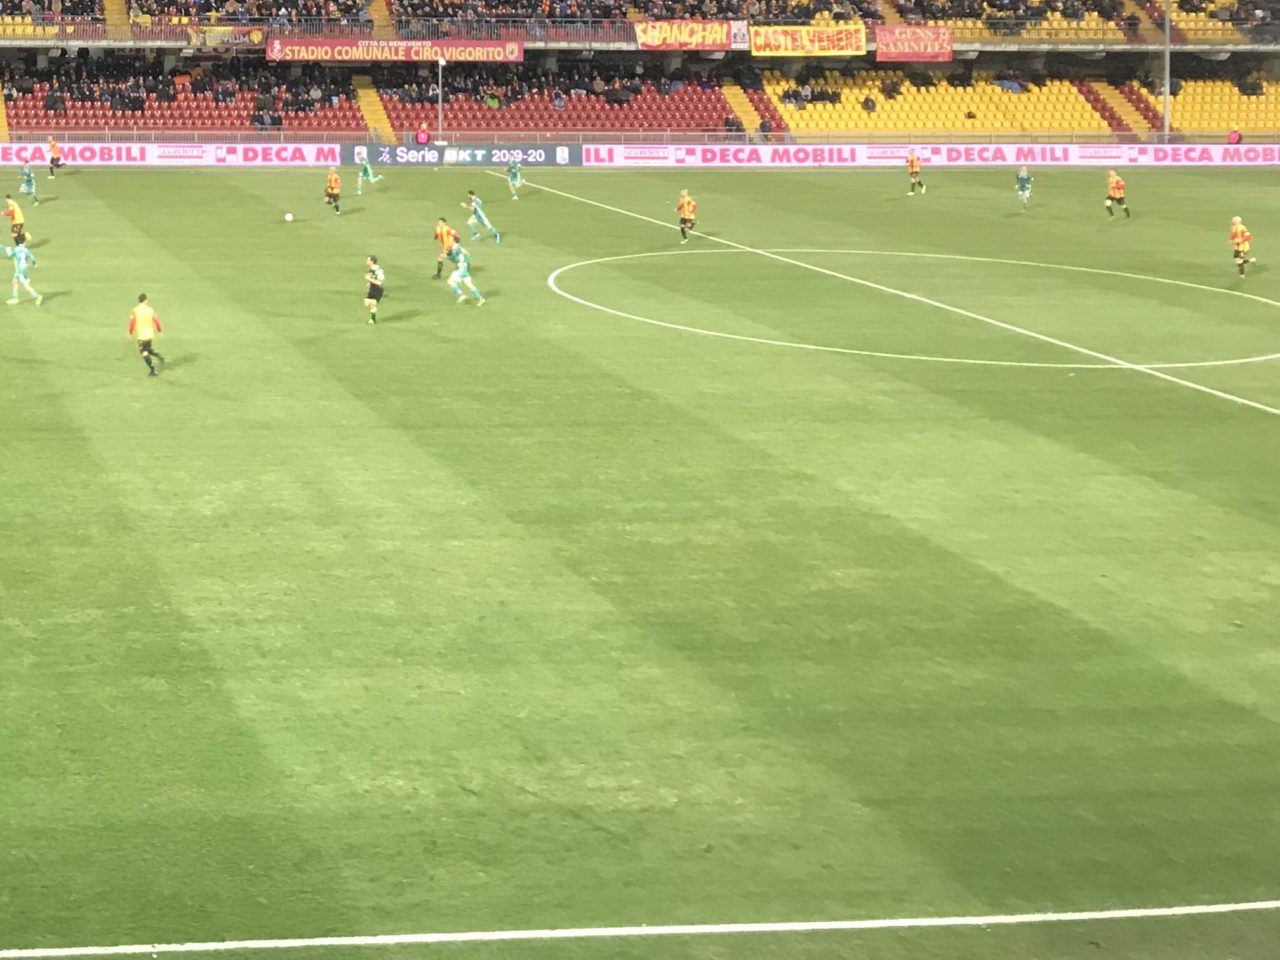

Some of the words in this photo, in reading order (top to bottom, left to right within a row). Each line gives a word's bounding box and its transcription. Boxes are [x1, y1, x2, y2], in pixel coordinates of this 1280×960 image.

[285, 46, 331, 60] STADIO
[334, 46, 405, 60] COMUNALE
[410, 47, 441, 60] CIRO
[443, 47, 504, 60] VIGORITO
[59, 146, 146, 162] MOBILI
[243, 146, 307, 162] DECA
[396, 147, 438, 162] Serie
[701, 147, 762, 163] DECA
[771, 147, 856, 163] MOBILI
[946, 147, 1007, 162] DECA
[1153, 147, 1213, 162] DECA
